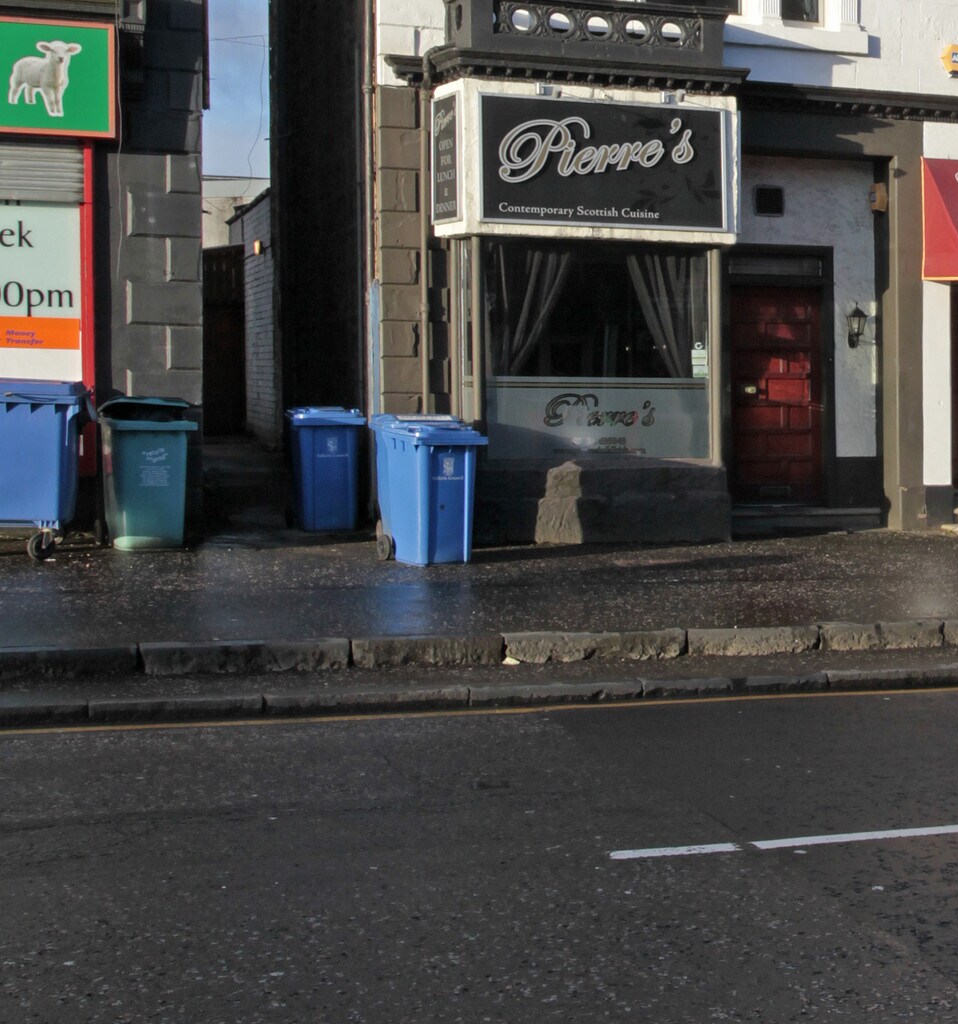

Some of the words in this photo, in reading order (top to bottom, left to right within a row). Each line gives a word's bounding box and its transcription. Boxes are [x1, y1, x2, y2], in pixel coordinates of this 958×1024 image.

[438, 138, 454, 151] OPEN
[499, 116, 695, 184] Pierre's
[440, 154, 452, 166] FOR
[437, 170, 456, 183] LUNCH
[436, 200, 457, 214] DINNER
[498, 202, 575, 218] Contemporary
[576, 205, 619, 218] Scottish
[621, 207, 660, 219] Cuisine
[6, 330, 36, 338] Money
[6, 338, 44, 346] Transfer
